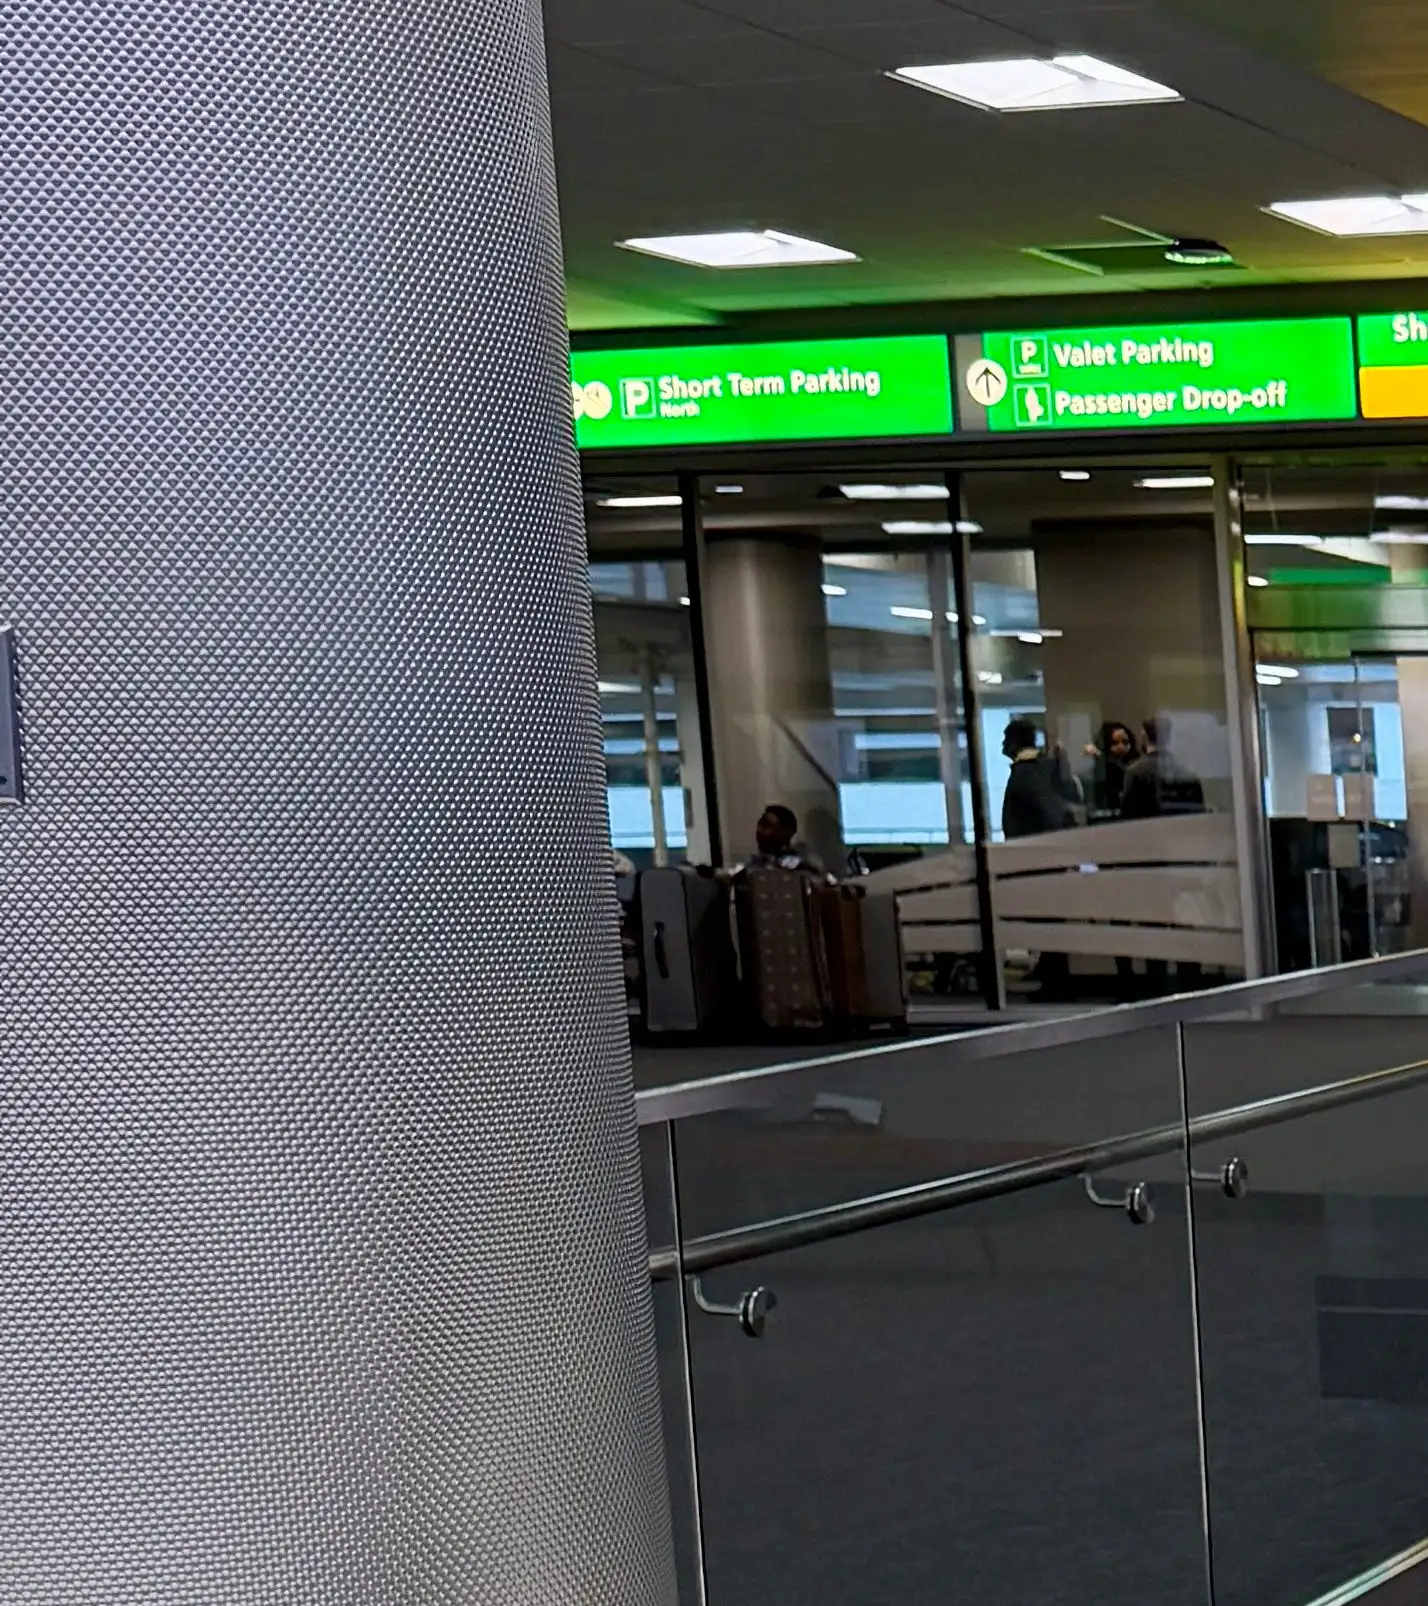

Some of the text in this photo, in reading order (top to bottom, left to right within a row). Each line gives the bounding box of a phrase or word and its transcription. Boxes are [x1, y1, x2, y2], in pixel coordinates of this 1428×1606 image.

[1052, 337, 1214, 368] Valet Parking
[658, 365, 882, 401] Short Term Parking
[1054, 378, 1289, 419] Passenger Drop-off
[658, 401, 701, 418] North
